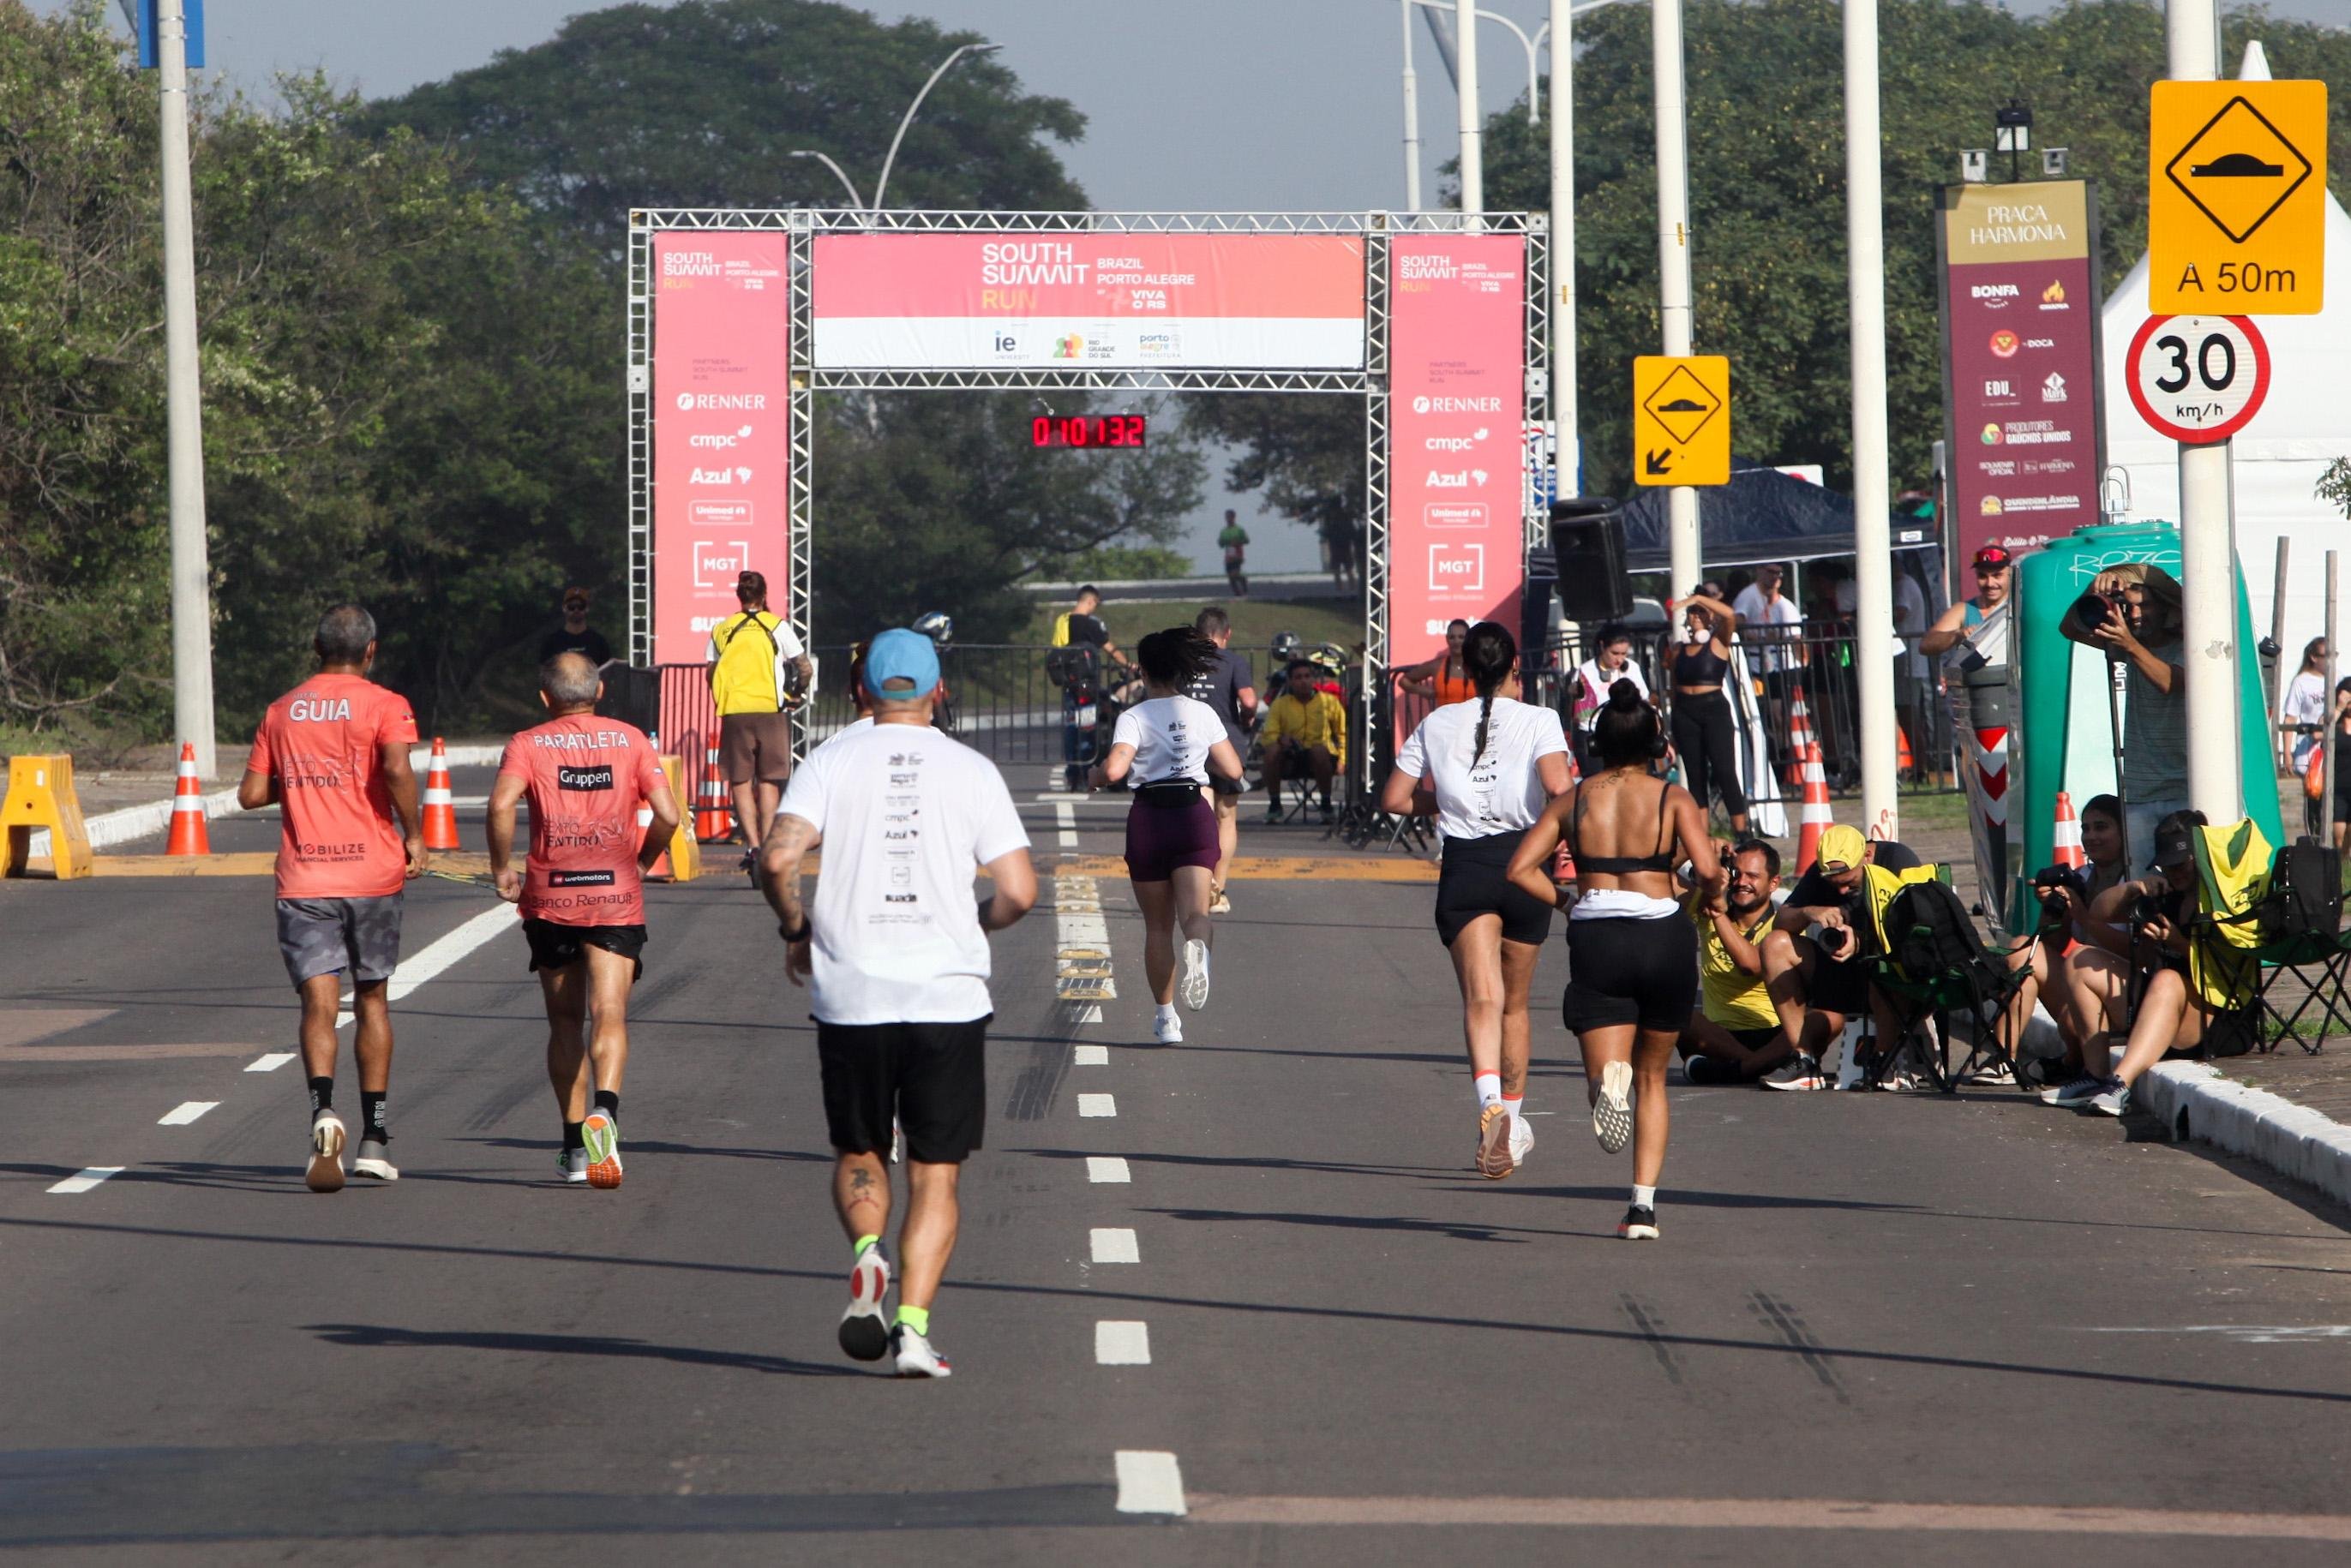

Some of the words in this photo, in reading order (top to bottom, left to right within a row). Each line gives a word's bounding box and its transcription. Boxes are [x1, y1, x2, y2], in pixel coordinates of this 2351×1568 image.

[1970, 224, 2066, 244] HARMONIA
[663, 252, 713, 264] SOUTH
[982, 242, 1073, 263] SOUTH
[1097, 258, 1144, 269] BRAZIL
[1400, 255, 1450, 266] SOUTH
[663, 264, 722, 276] SUMMIT
[982, 264, 1091, 284] SUMMIT
[1400, 266, 1460, 278] SUMMIT
[663, 278, 694, 289] RUN
[1097, 274, 1142, 284] PORTO
[1144, 274, 1195, 284] ALEGRE
[2177, 262, 2204, 292] A
[2217, 262, 2296, 292] 50m
[1400, 281, 1431, 292] RUN
[1971, 284, 2020, 298] BONFA
[982, 290, 1036, 309] RUN
[1131, 290, 1166, 299] VIVA
[1132, 300, 1143, 308] O
[1147, 300, 1166, 308] RS
[995, 330, 1016, 351] ie
[1139, 335, 1169, 344] porto
[2027, 338, 2054, 348] DOCA
[2155, 332, 2236, 393] 30
[697, 394, 765, 410] RENNER
[1432, 397, 1502, 412] RENNER
[2176, 403, 2223, 419] km/h
[2006, 420, 2054, 432] PRODUTORES
[689, 434, 737, 451] cmpc
[2042, 431, 2072, 442] UNIDOS
[1425, 438, 1473, 452] cmpc
[689, 467, 732, 484] Azul
[1425, 470, 1467, 488] Azul
[696, 506, 734, 515] Unimed
[1431, 508, 1470, 518] Unimed
[704, 558, 738, 571] MGT
[1438, 560, 1473, 573] MGT
[289, 698, 351, 721] GUIA
[533, 731, 629, 750] PARATLETA
[560, 769, 610, 787] Gruppen
[885, 830, 908, 840] Azul
[565, 874, 610, 883] webmotors
[531, 895, 573, 909] Banco
[575, 892, 633, 908] Renault
